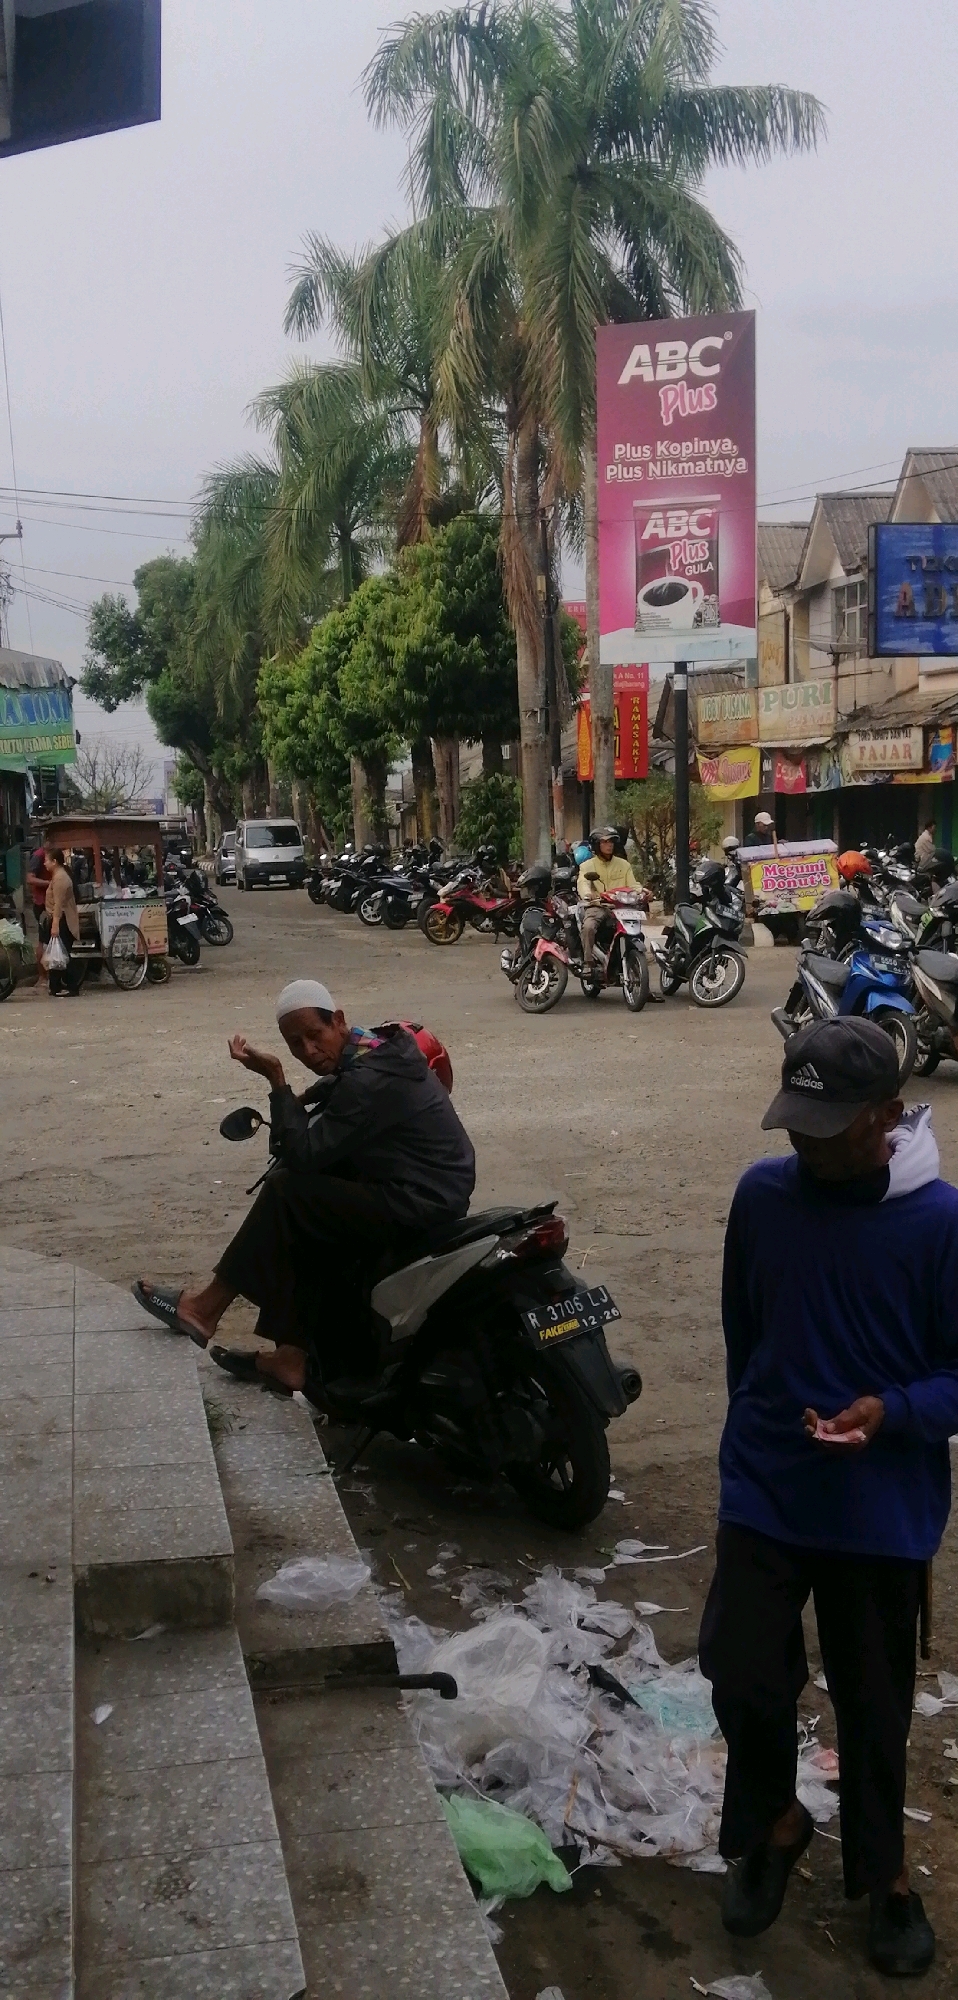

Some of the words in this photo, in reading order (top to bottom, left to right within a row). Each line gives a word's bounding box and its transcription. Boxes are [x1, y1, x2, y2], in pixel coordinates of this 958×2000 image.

[617, 336, 724, 384] ABC
[659, 381, 717, 426] Plus
[614, 443, 651, 461] Plus
[655, 437, 739, 461] Kopinya,
[605, 464, 643, 483] Plus
[647, 457, 748, 480] Nikmatnya
[641, 508, 713, 539] ABC
[669, 539, 709, 571] Plus
[685, 561, 714, 576] GULA
[721, 692, 752, 721] BUSANA
[762, 682, 832, 712] PURI
[859, 743, 912, 761] FAJAR
[762, 860, 826, 878] Megumi
[762, 873, 831, 892] Donut's
[790, 1075, 824, 1090] adidas
[151, 1296, 176, 1314] SUPER
[527, 1312, 540, 1329] R
[547, 1296, 584, 1321] 3706
[587, 1287, 608, 1307] LJ
